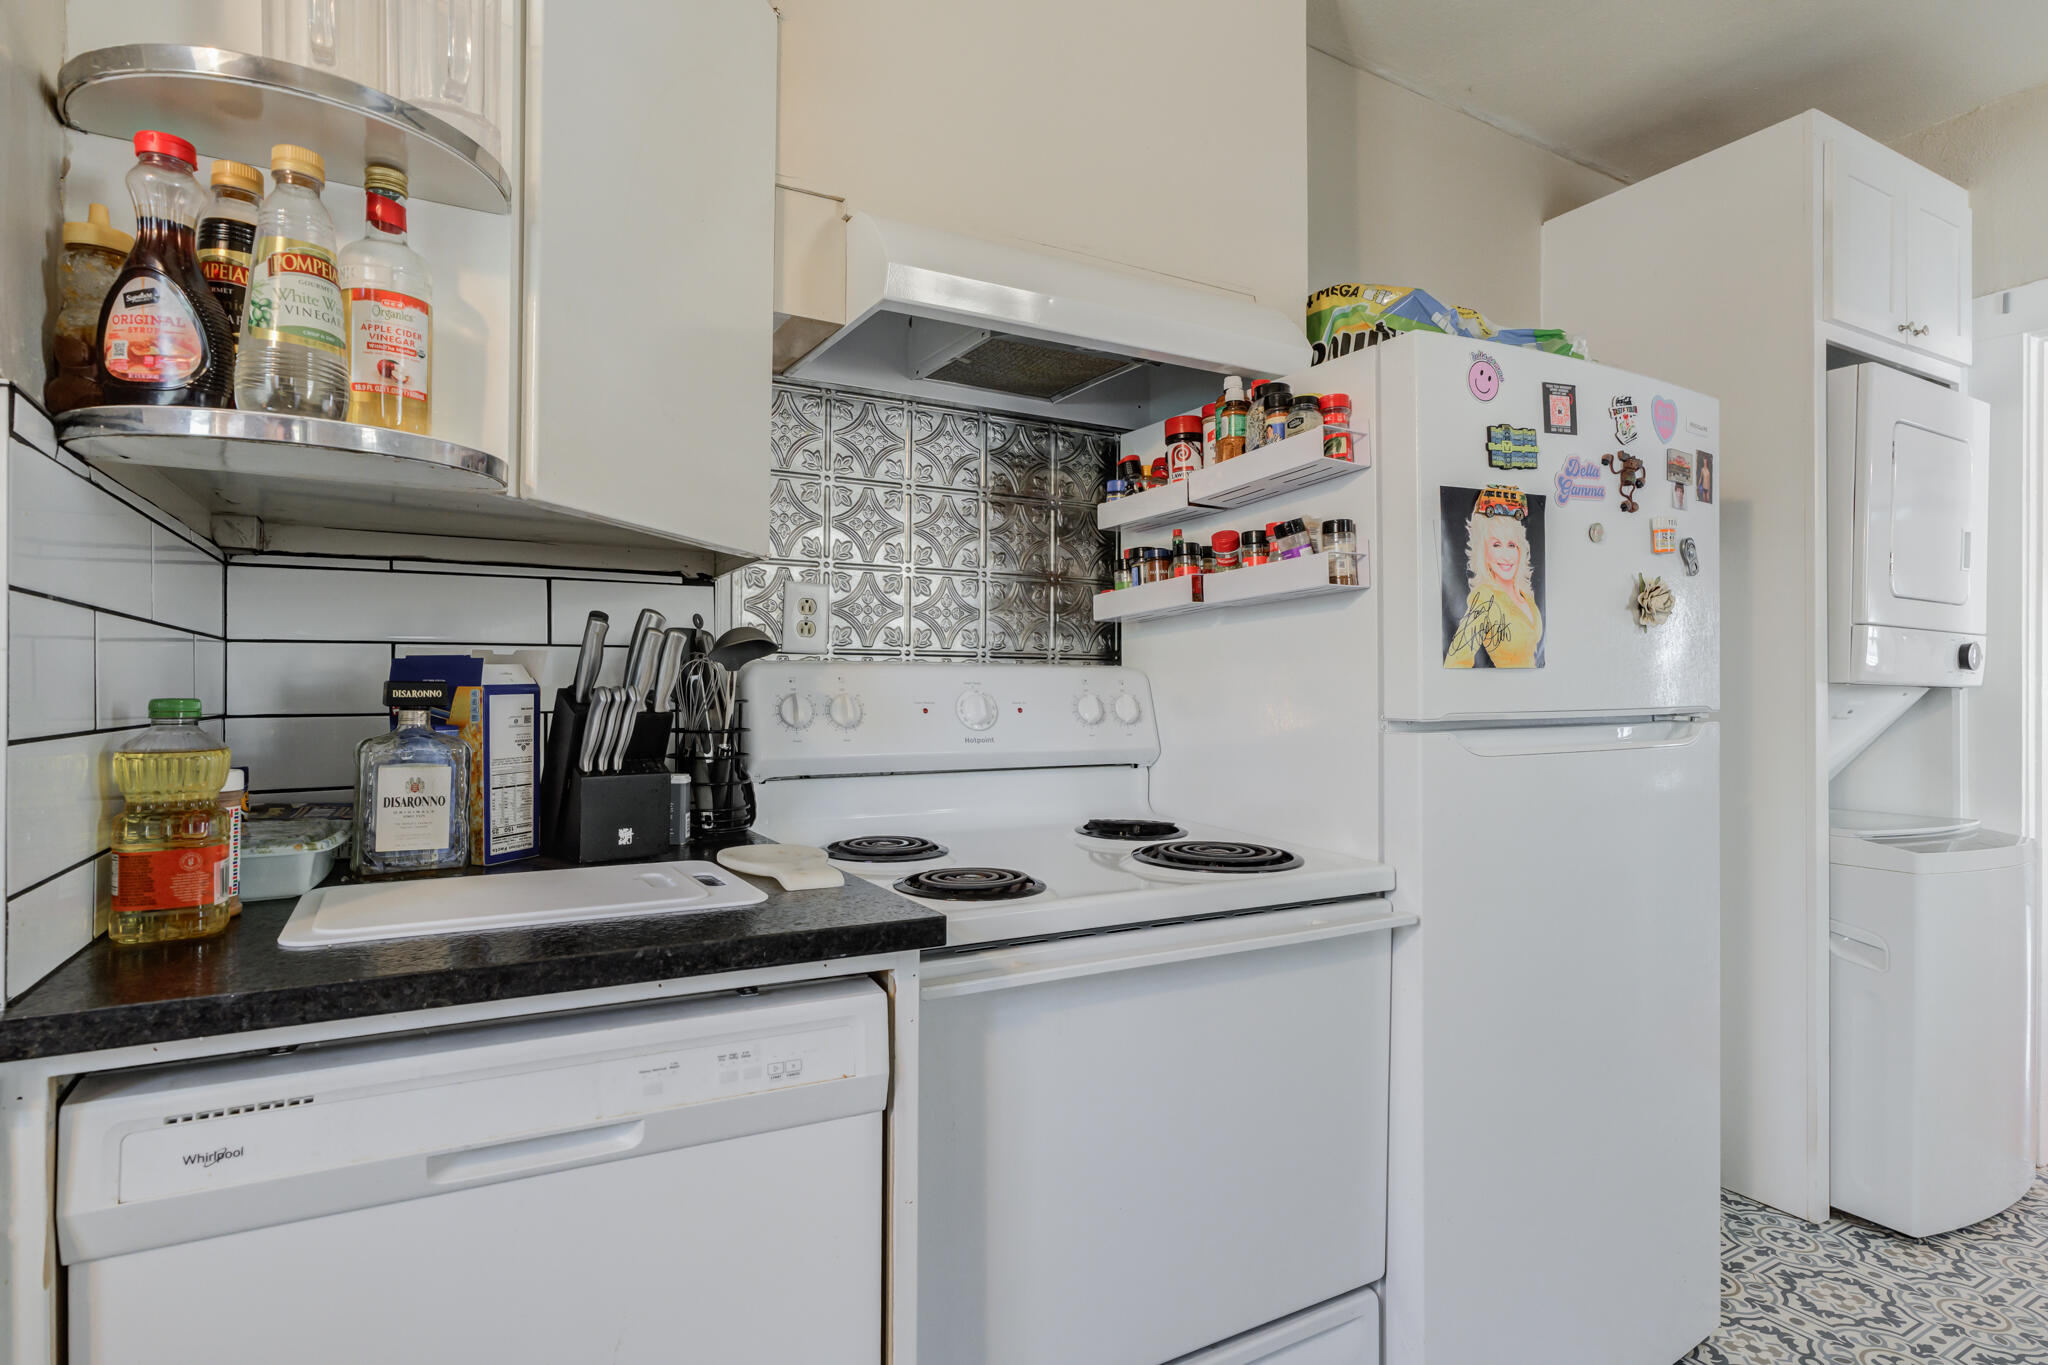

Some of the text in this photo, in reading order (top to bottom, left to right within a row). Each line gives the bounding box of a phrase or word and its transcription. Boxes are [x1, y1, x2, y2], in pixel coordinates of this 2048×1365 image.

[203, 263, 249, 285] MPEIA
[274, 254, 339, 283] POMPEIA
[273, 287, 320, 307] White
[1316, 284, 1360, 301] MEGA
[112, 314, 186, 328] ORIGINAL
[361, 323, 423, 341] APPLE CIDER
[369, 333, 416, 348] VINEGAR
[1558, 476, 1605, 503] Gamma
[392, 689, 442, 698] DISARONNO
[964, 736, 994, 745] Hotpoint
[383, 795, 446, 809] DISARONNO
[183, 1147, 244, 1168] Whirlpool
